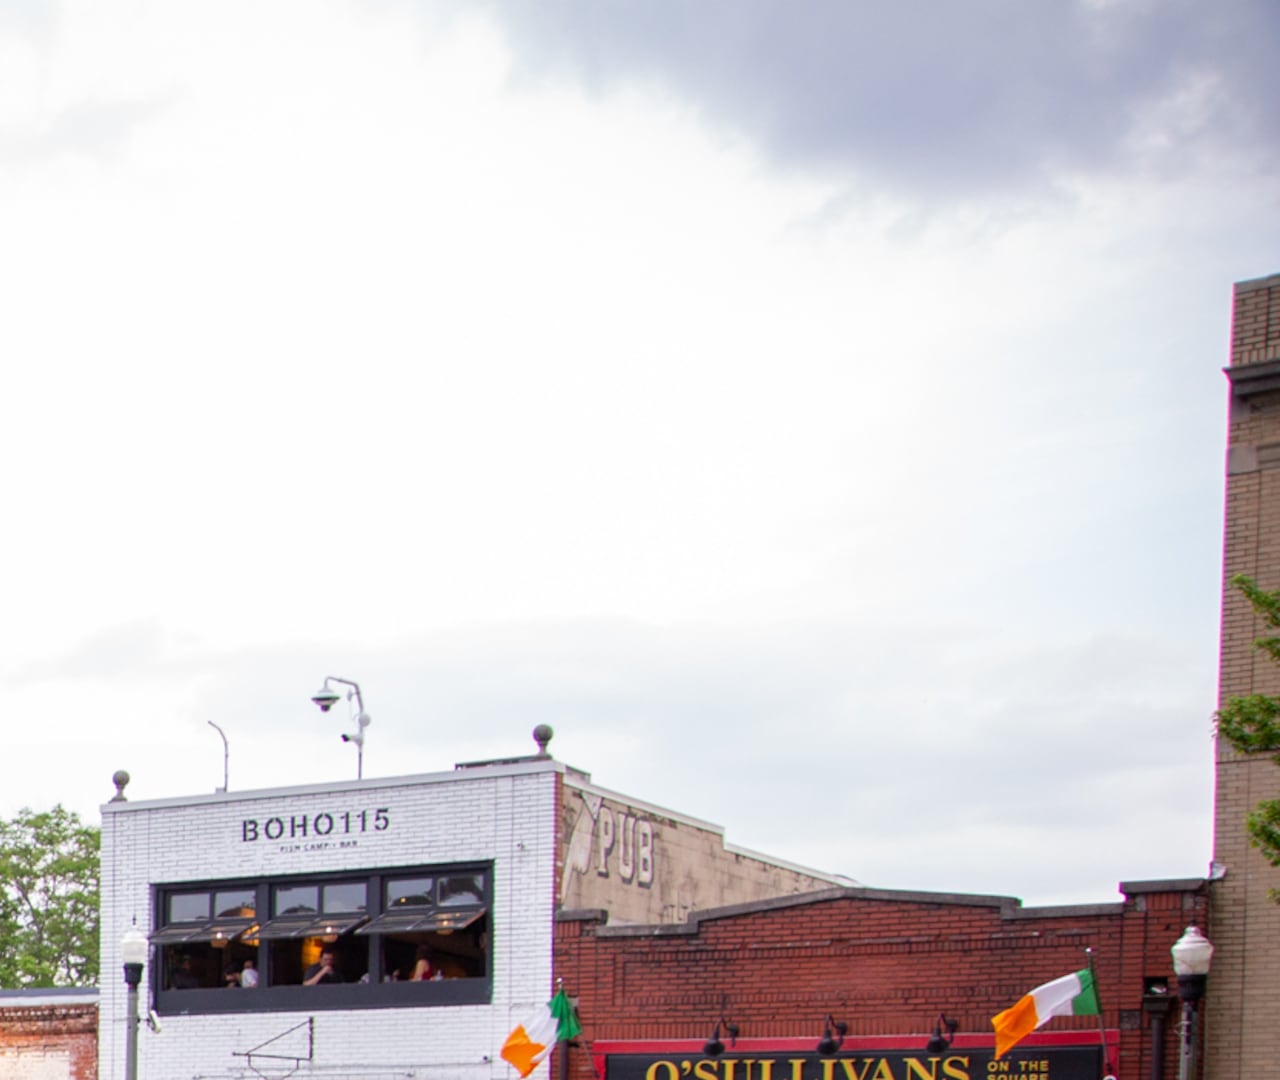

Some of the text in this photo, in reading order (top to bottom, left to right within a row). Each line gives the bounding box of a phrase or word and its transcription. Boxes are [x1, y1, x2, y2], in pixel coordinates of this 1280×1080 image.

[242, 807, 389, 842] BOHO115
[597, 806, 654, 889] PUB
[987, 1061, 1010, 1072] ON
[1018, 1060, 1050, 1072] THE
